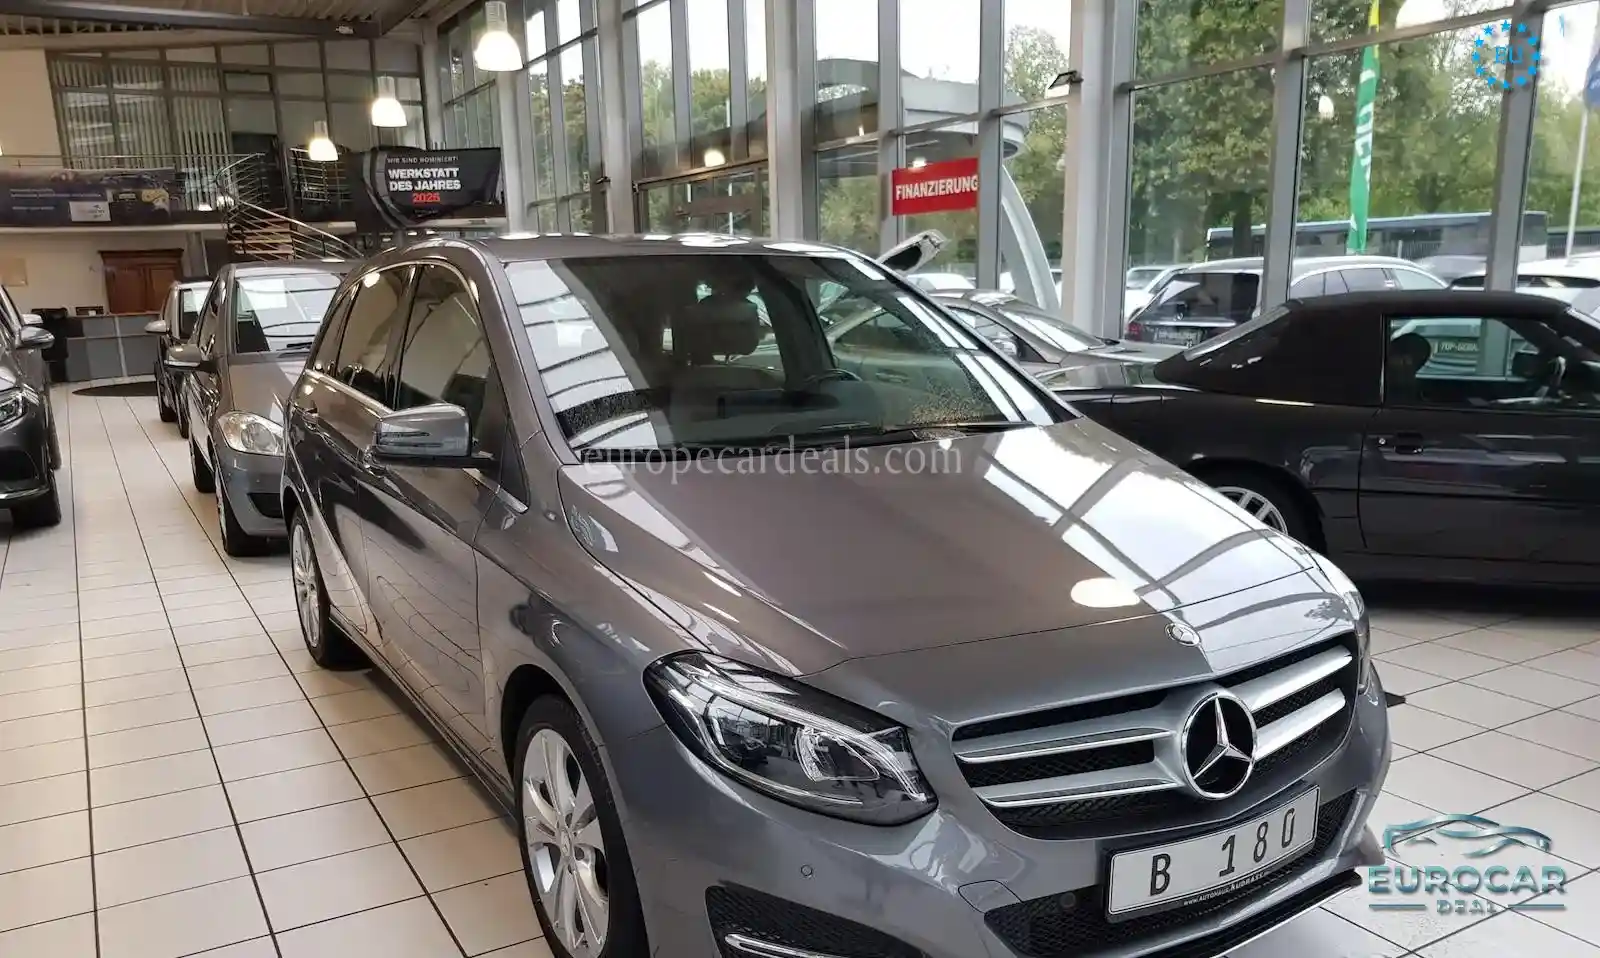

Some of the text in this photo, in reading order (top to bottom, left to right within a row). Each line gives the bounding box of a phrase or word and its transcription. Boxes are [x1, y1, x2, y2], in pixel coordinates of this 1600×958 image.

[387, 167, 460, 179] WERKSTATT
[389, 179, 462, 192] DES JAHRES
[895, 174, 979, 201] FINANZIERUNG
[1150, 807, 1296, 896] B 180
